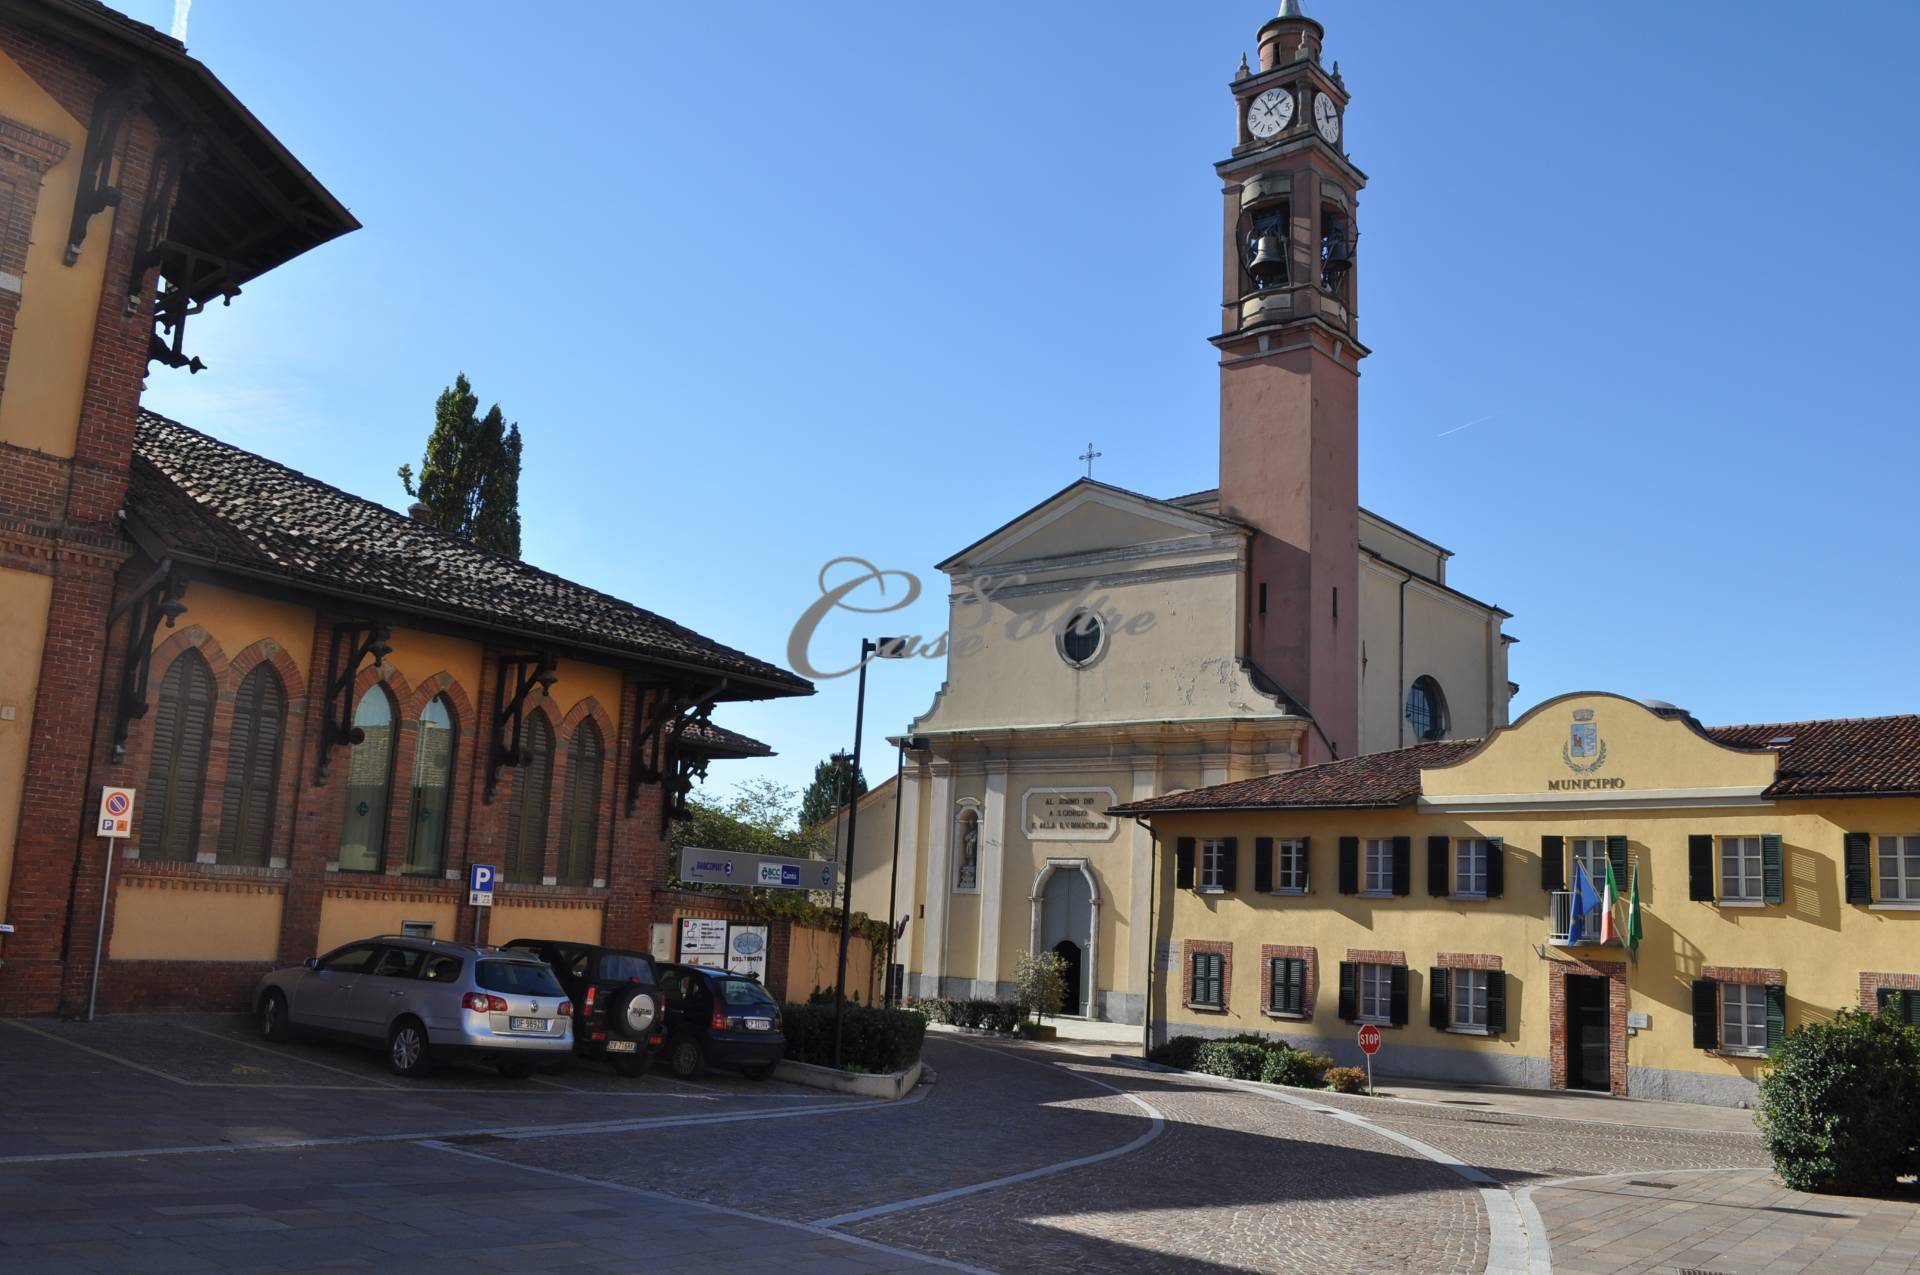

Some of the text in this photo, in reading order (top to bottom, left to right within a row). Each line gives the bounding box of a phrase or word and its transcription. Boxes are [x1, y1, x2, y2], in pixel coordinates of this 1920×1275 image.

[1548, 778, 1625, 791] MUNICIPIO
[767, 867, 781, 877] BCC
[475, 867, 491, 890] P
[1360, 1033, 1379, 1045] STOP
